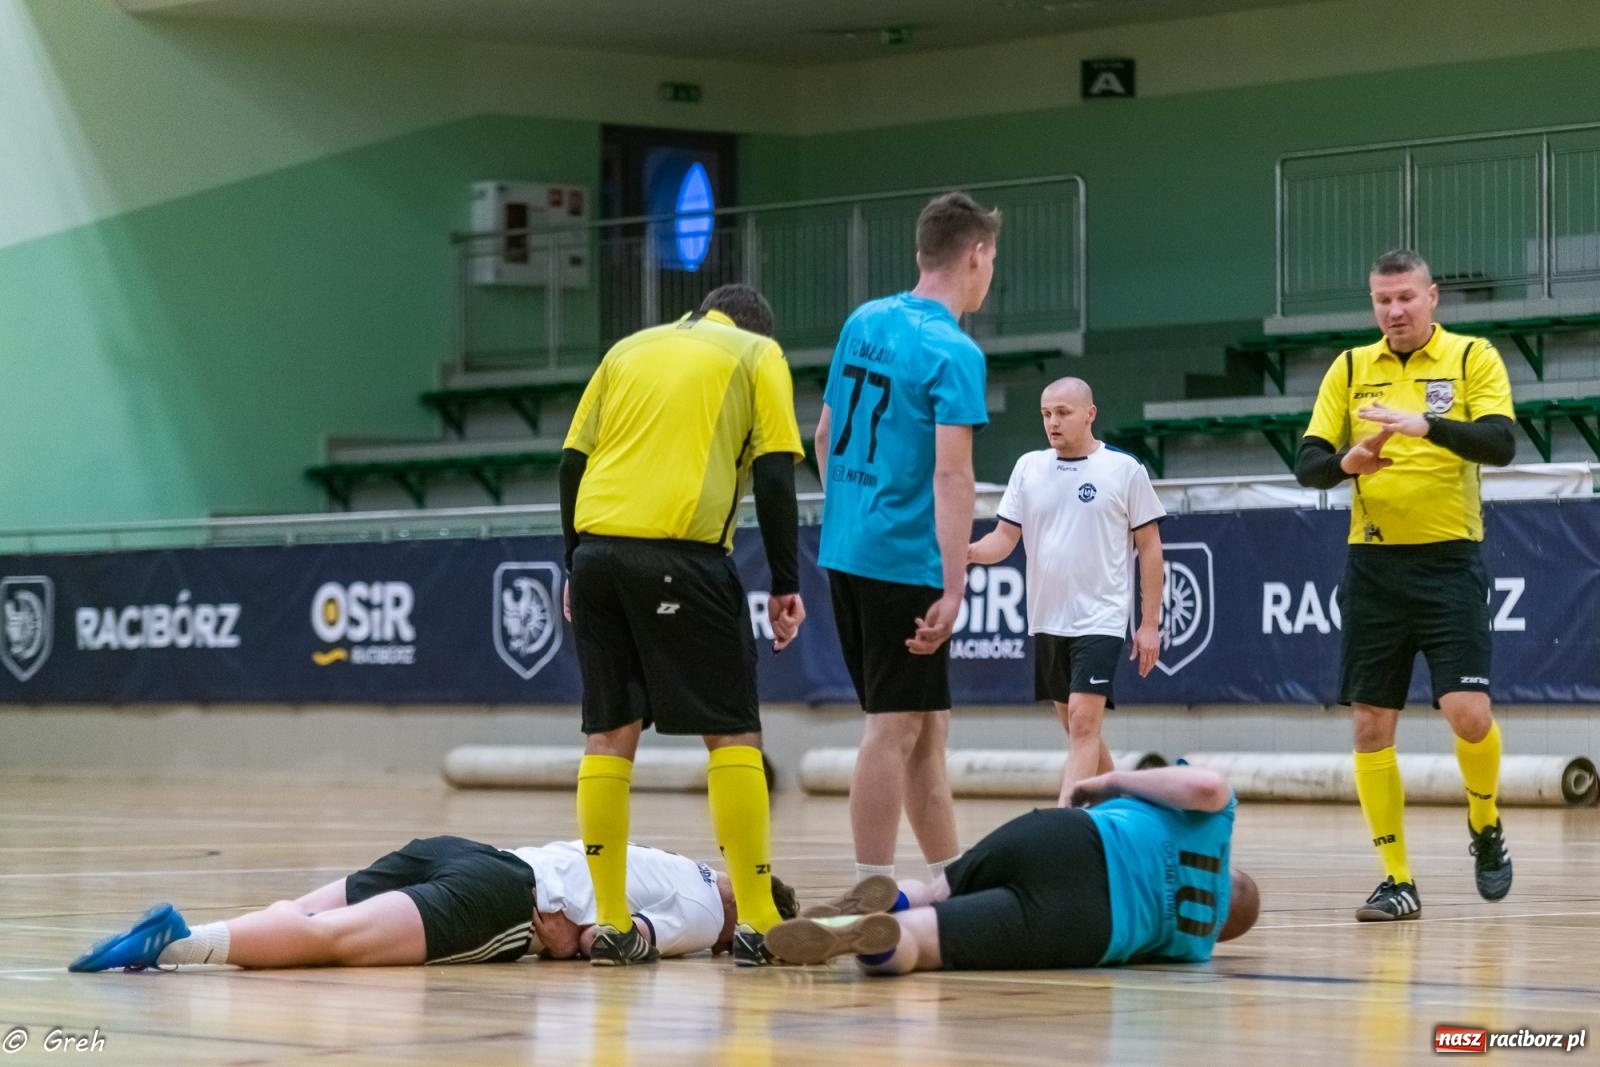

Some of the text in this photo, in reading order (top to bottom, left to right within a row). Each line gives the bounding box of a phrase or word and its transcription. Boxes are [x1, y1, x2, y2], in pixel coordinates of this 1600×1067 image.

[1090, 72, 1125, 94] A
[832, 364, 891, 464] 77
[76, 589, 241, 650] RACIBÓRZ
[311, 581, 416, 643] OSiR
[950, 633, 1025, 659] ACIBÓRZ
[1175, 849, 1222, 938] 10
